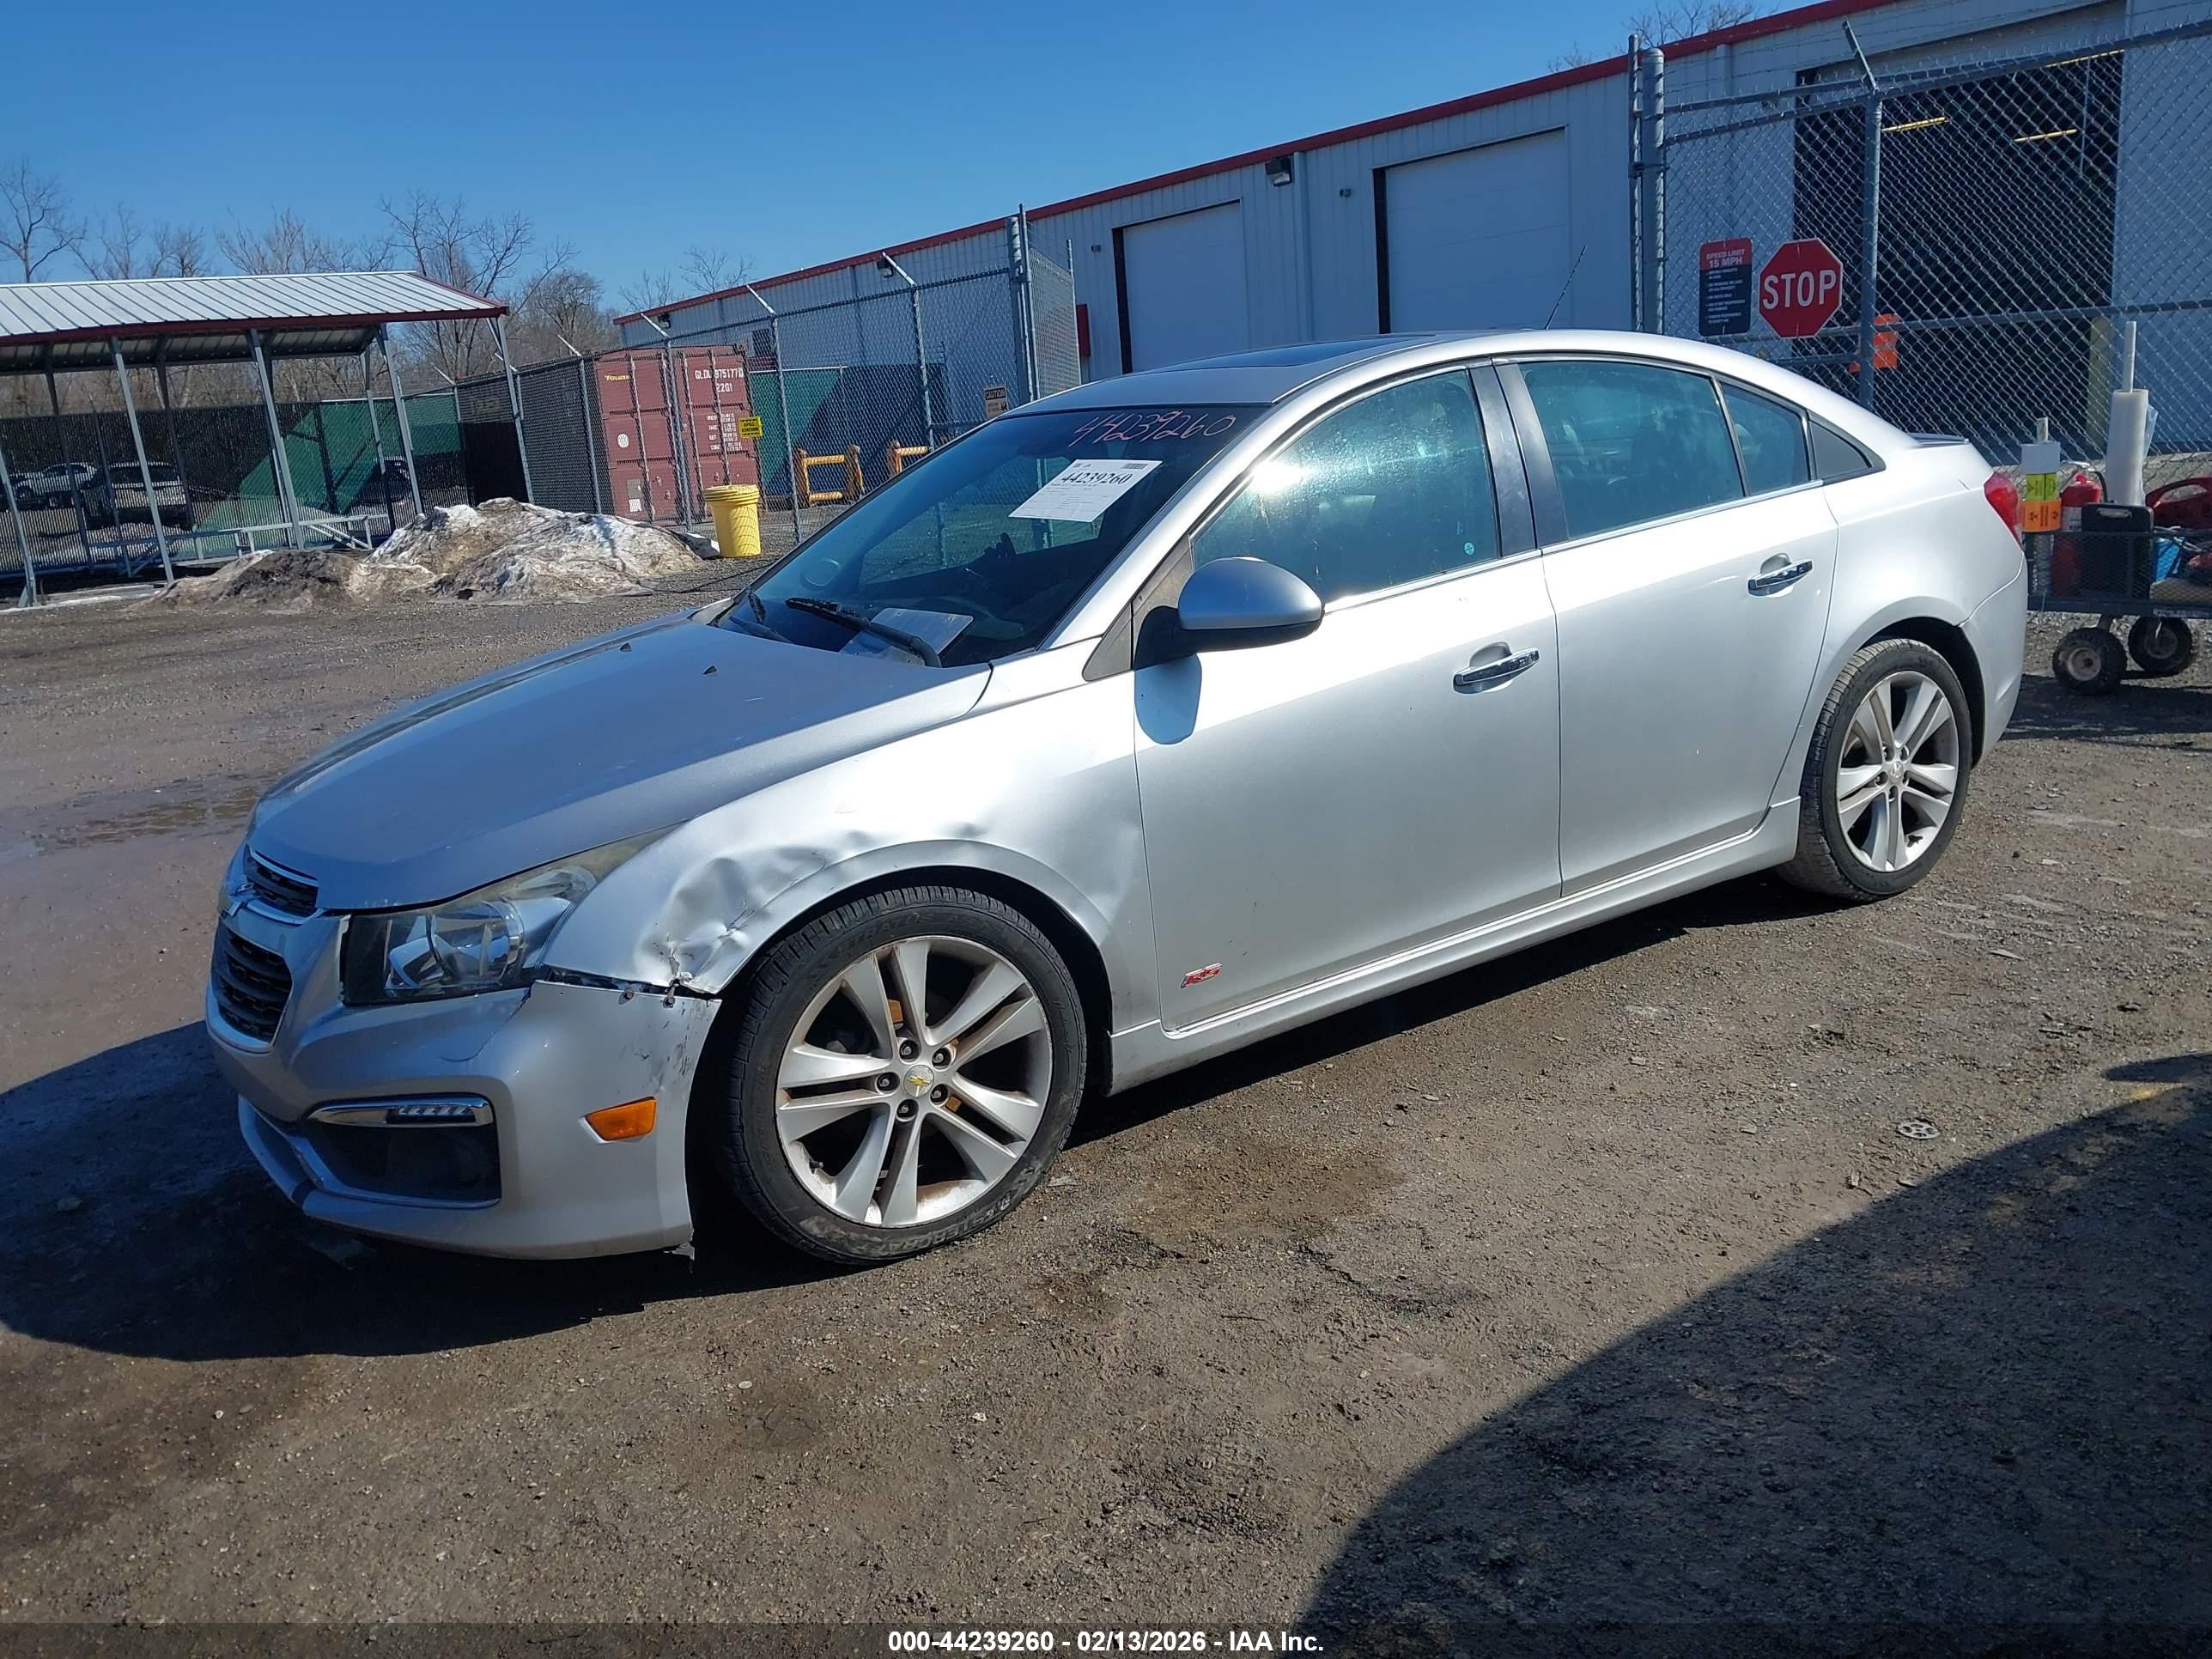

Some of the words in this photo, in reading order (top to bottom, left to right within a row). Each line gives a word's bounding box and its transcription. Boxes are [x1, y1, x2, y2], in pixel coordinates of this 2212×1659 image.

[1710, 259, 1719, 268] 15
[1722, 256, 1742, 266] MPH
[1763, 270, 1837, 310] STOP
[1068, 410, 1237, 447] 44239260
[1061, 472, 1133, 485] 44239260
